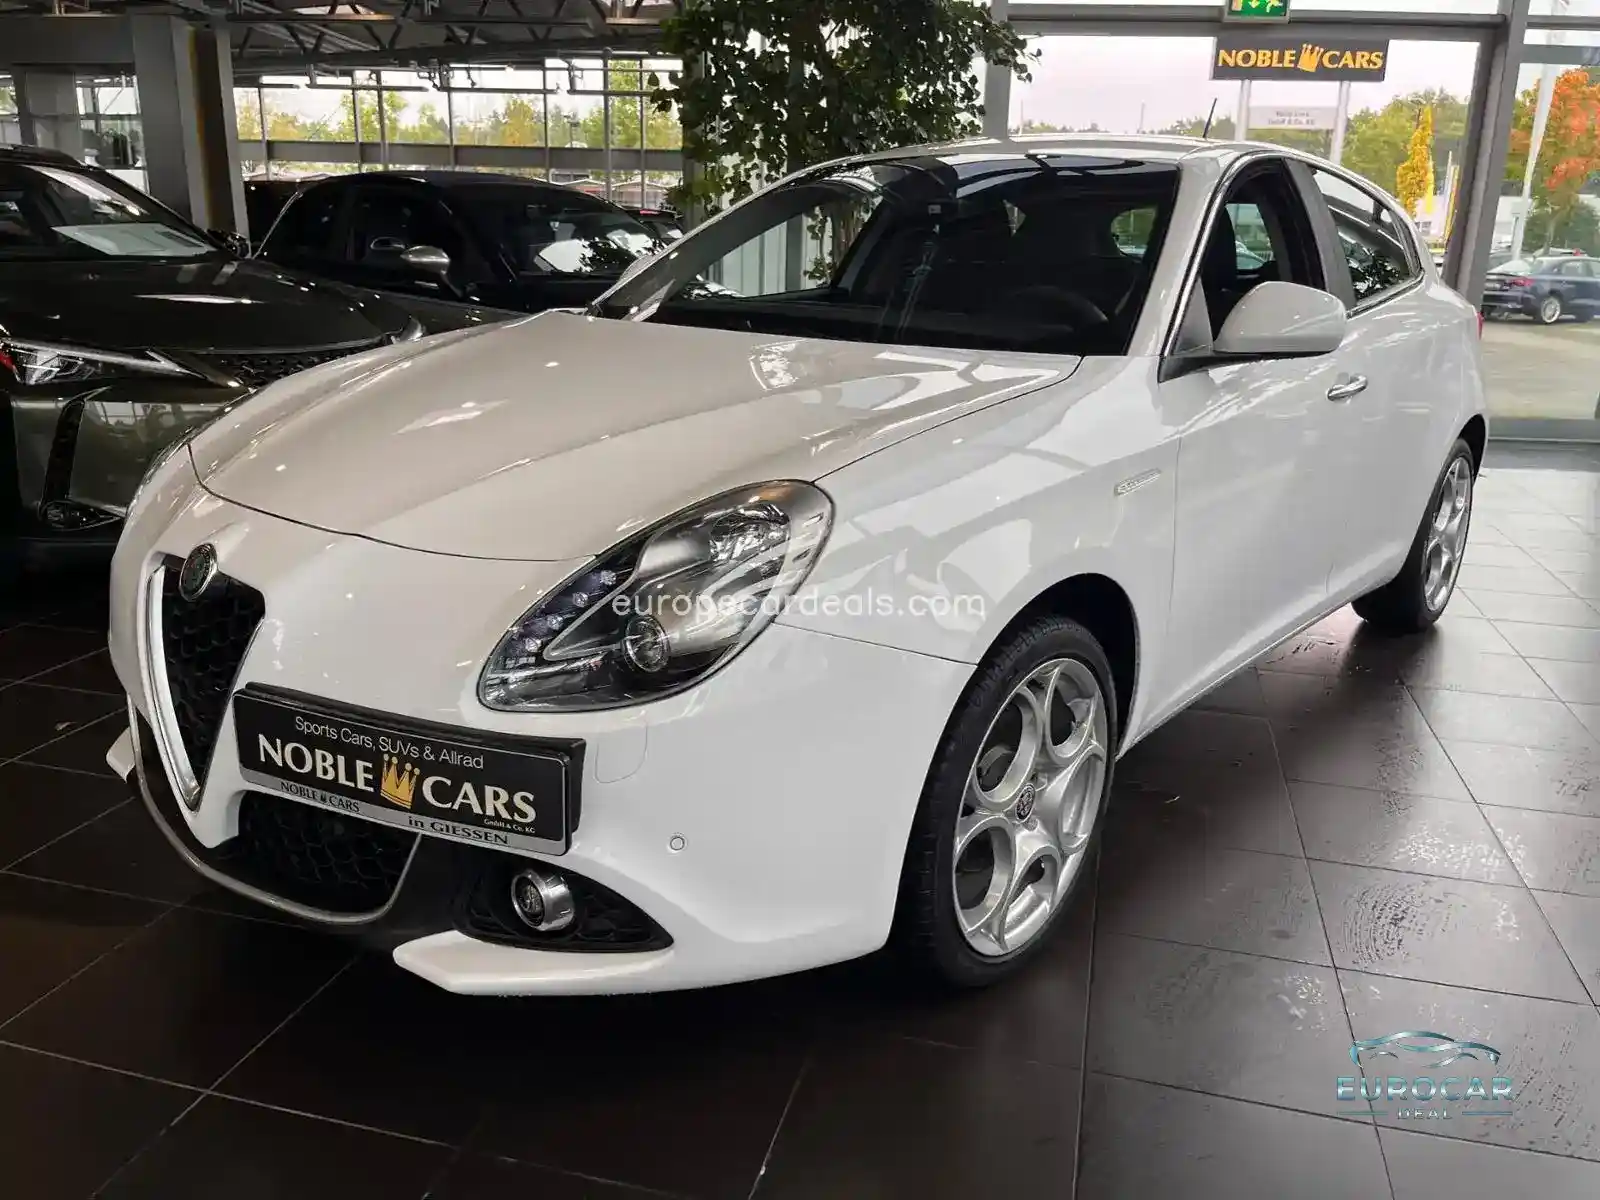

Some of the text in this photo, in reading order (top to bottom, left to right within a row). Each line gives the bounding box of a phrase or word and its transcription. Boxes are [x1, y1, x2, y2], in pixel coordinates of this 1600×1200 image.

[1218, 49, 1383, 70] NOBLE CARS
[295, 716, 485, 770] Sports Cars, SUVs & Allrad
[257, 734, 537, 824] NOBLE CARS
[280, 781, 361, 813] NOBLE CARS
[408, 815, 509, 845] in GIESSEN
[484, 818, 505, 828] GmbH
[525, 826, 536, 834] KG
